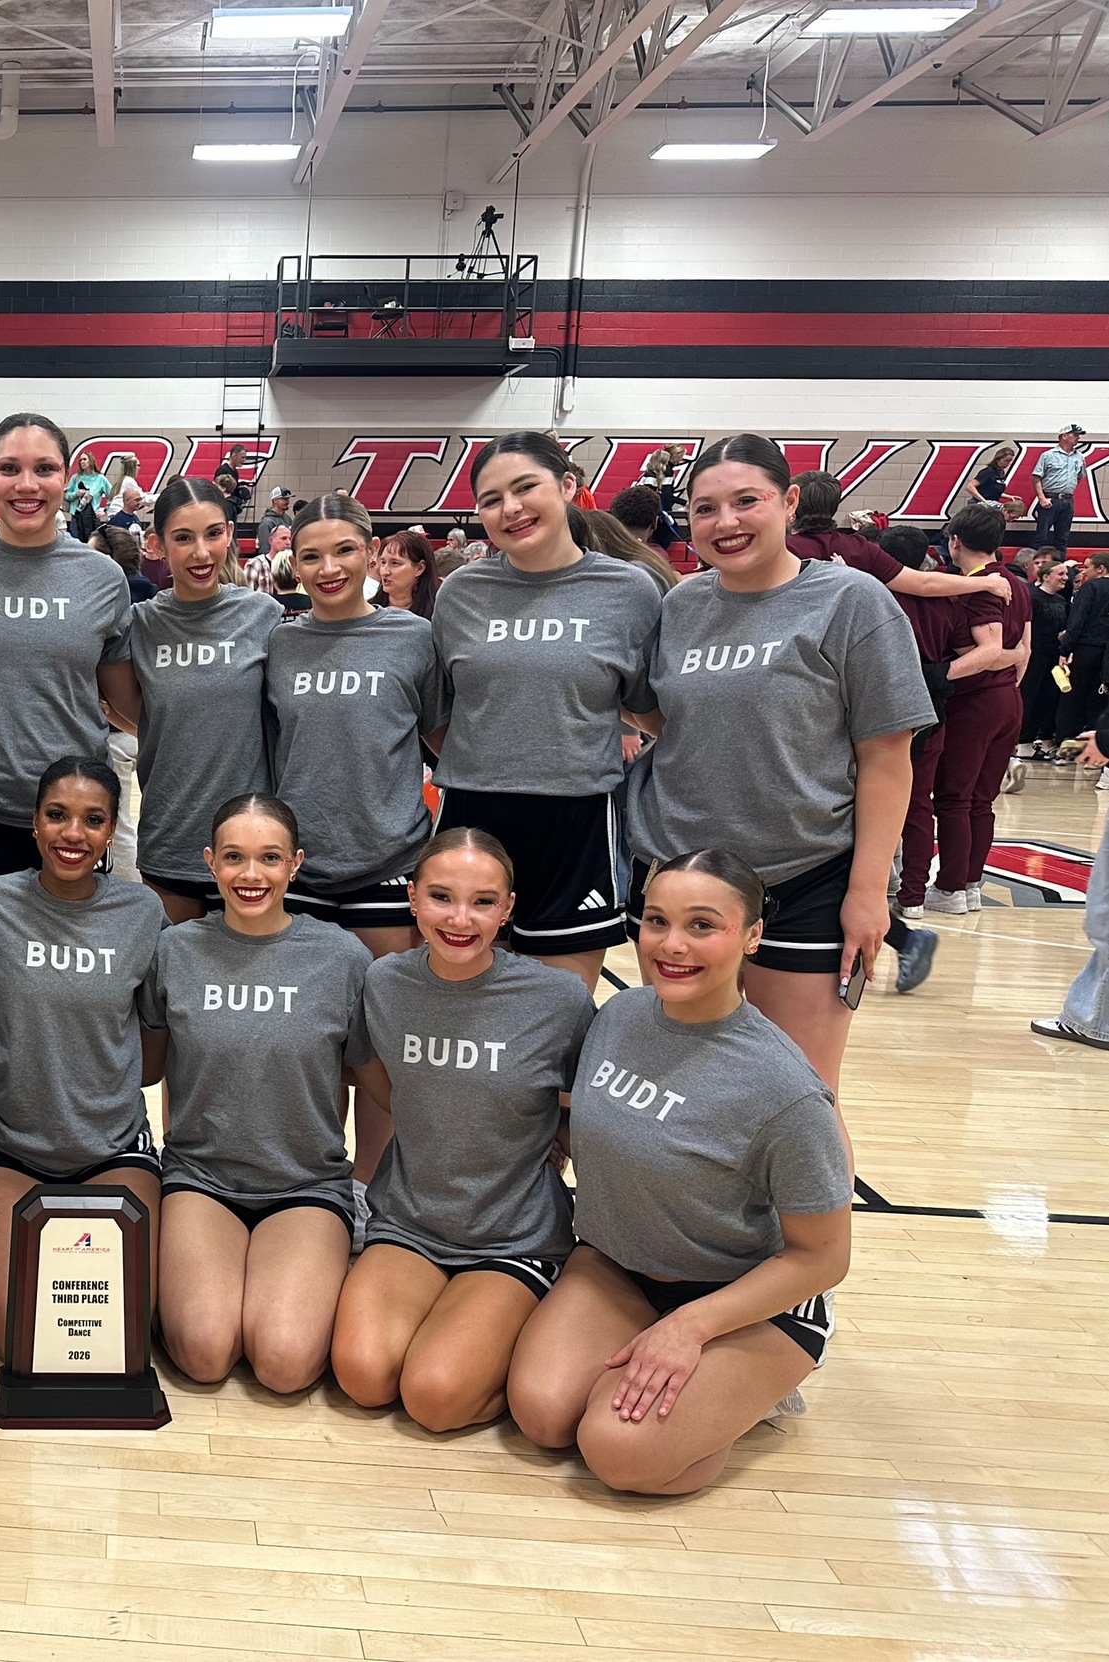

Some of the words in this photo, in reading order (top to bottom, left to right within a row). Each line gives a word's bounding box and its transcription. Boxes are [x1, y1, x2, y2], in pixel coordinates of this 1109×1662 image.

[485, 617, 591, 643] BUDT
[155, 641, 236, 668] BUDT
[679, 639, 783, 675] BUDT
[293, 670, 385, 696] BUDT
[25, 940, 116, 975] BUDT
[202, 984, 299, 1013] BUDT
[403, 1033, 507, 1072] BUDT
[589, 1059, 687, 1122] BUDT
[52, 1280, 109, 1291] CONFERENCE
[52, 1294, 80, 1304] THIRD
[81, 1294, 109, 1304] PLACE
[68, 1351, 90, 1360] 2026
